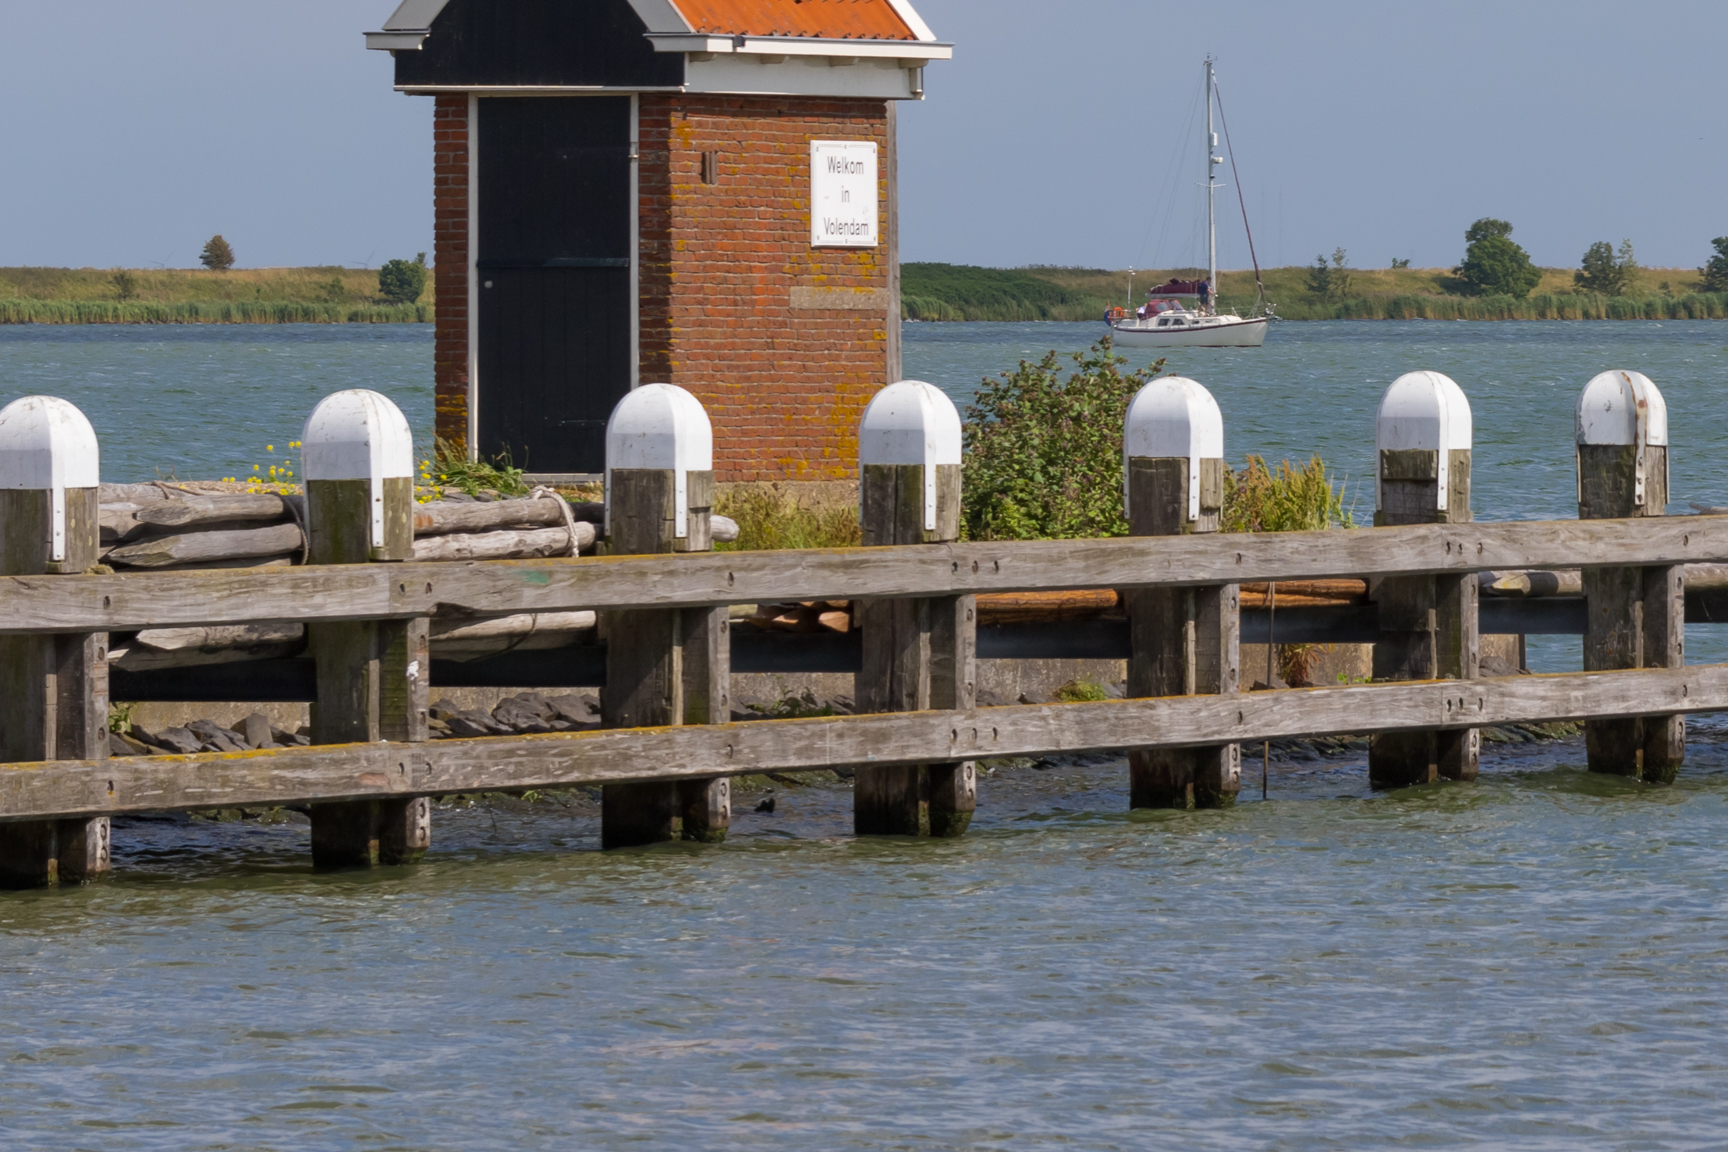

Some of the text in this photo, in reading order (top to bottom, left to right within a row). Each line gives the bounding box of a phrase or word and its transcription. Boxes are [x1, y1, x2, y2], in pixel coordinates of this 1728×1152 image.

[827, 156, 864, 174] Welkom
[841, 185, 850, 203] in
[823, 217, 869, 236] Volendam
